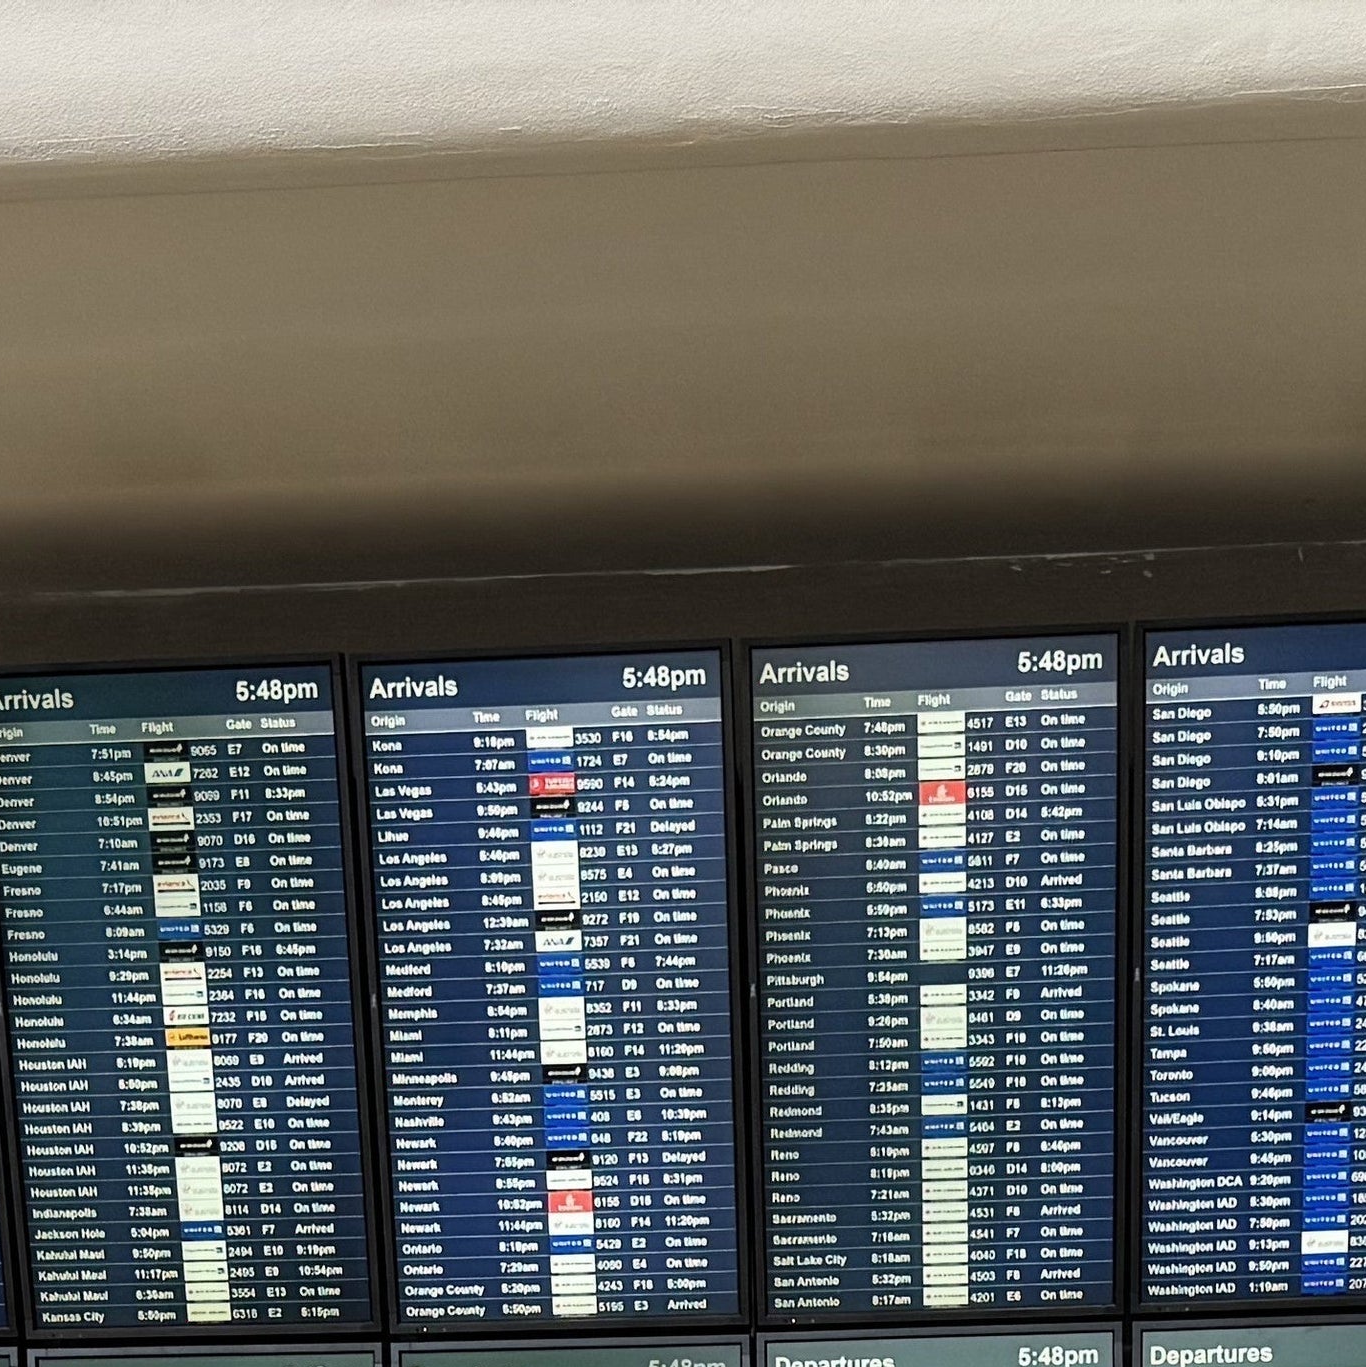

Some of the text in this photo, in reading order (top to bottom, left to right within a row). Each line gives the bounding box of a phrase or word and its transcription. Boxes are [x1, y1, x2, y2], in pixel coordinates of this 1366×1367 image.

[1152, 642, 1244, 666] Arrivals
[759, 649, 1102, 683] Arrivals 5:48pm
[236, 679, 318, 704] 5:48pm
[369, 665, 706, 698] Arrivals 5:48pm
[1152, 682, 1188, 696] Origin
[1258, 678, 1286, 690] Time
[1313, 675, 1346, 689] Flight
[760, 688, 1077, 713] Origin Time Flight Gate Status
[371, 704, 682, 728] Origin Time Flight Gate Status
[1152, 708, 1175, 720] San
[1177, 707, 1211, 720] Diego
[89, 724, 116, 734] Time
[141, 721, 173, 735] Flight
[225, 718, 251, 729] Gate
[260, 717, 295, 728] Status
[761, 713, 1085, 738] Orange County 4517 On time
[91, 748, 131, 760] 7:51pm
[227, 743, 242, 754] E7
[261, 742, 278, 753] On
[280, 742, 305, 752] time
[579, 823, 603, 835] 1112
[650, 819, 695, 834] Delayed
[1, 863, 42, 876] Eugene
[379, 851, 447, 866] Los Angeles
[1150, 1345, 1272, 1367] Departures
